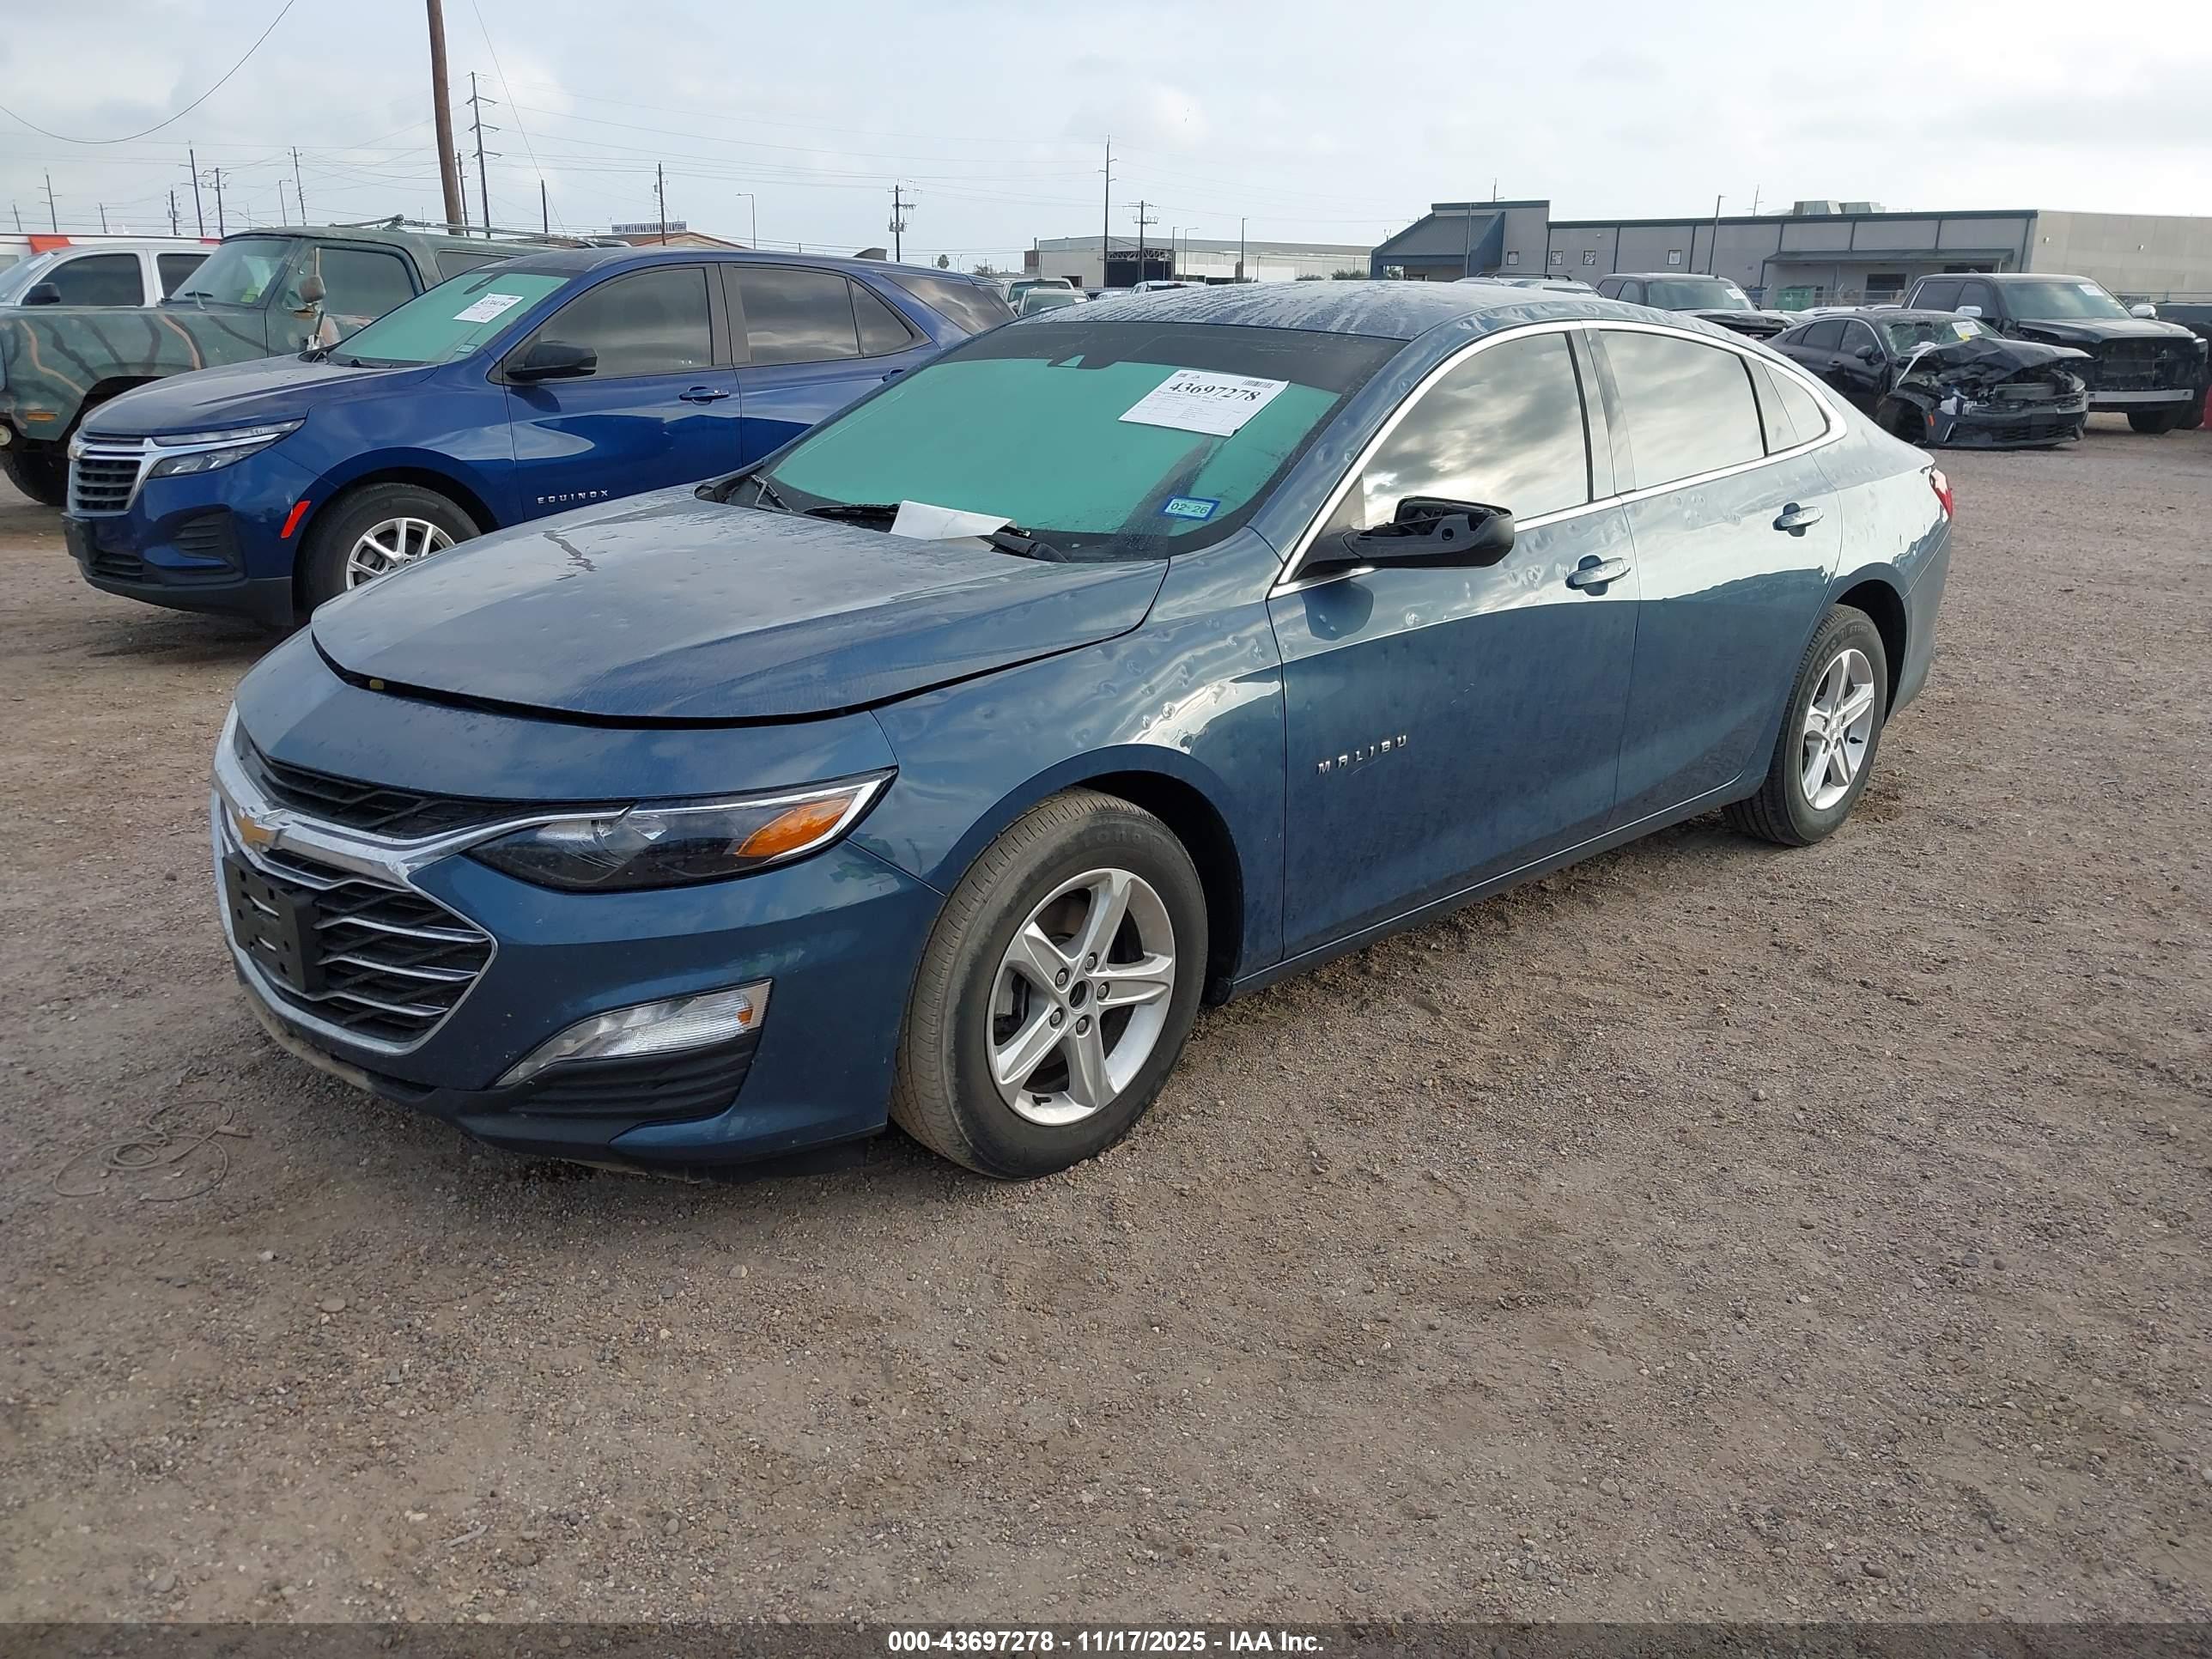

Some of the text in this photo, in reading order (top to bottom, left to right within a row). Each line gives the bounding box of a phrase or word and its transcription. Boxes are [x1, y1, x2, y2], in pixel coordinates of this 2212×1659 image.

[1169, 382, 1261, 402] 43697278
[537, 489, 609, 503] EQUINOX
[1317, 734, 1407, 775] MALIBU
